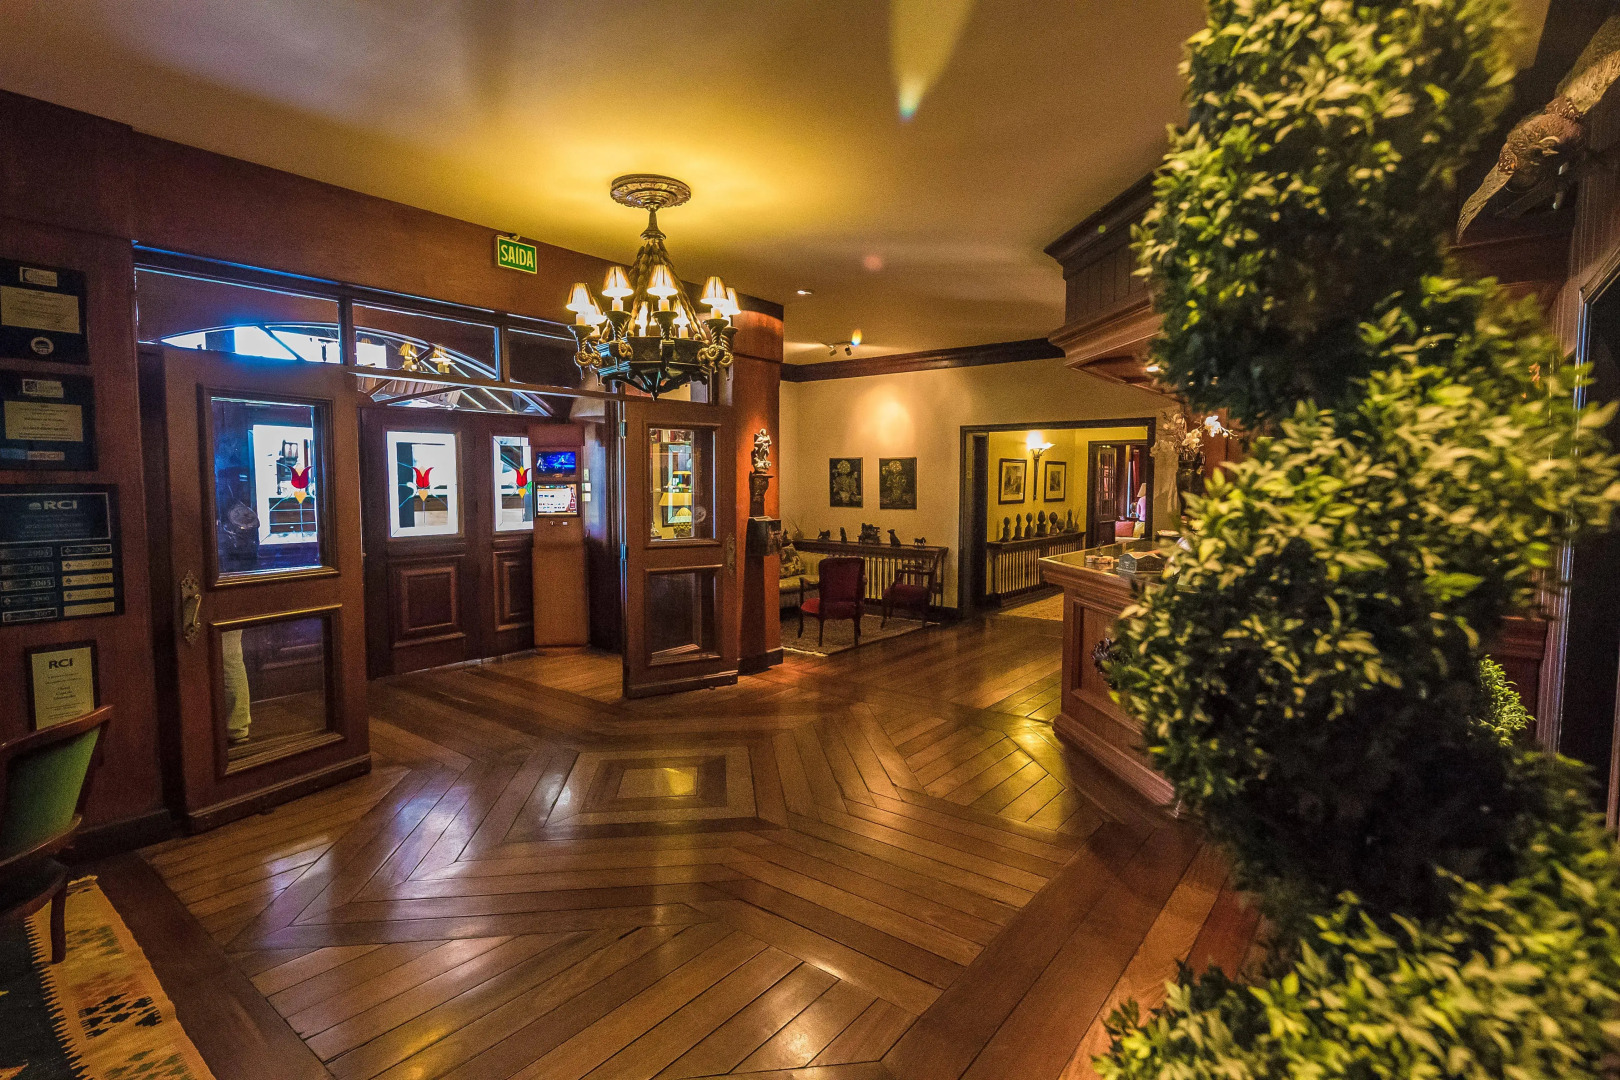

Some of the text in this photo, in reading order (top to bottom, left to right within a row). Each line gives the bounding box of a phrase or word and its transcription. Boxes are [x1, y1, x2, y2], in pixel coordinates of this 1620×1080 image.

[501, 244, 534, 268] SAÍDA
[43, 499, 78, 510] RCI
[48, 658, 74, 669] RCI
